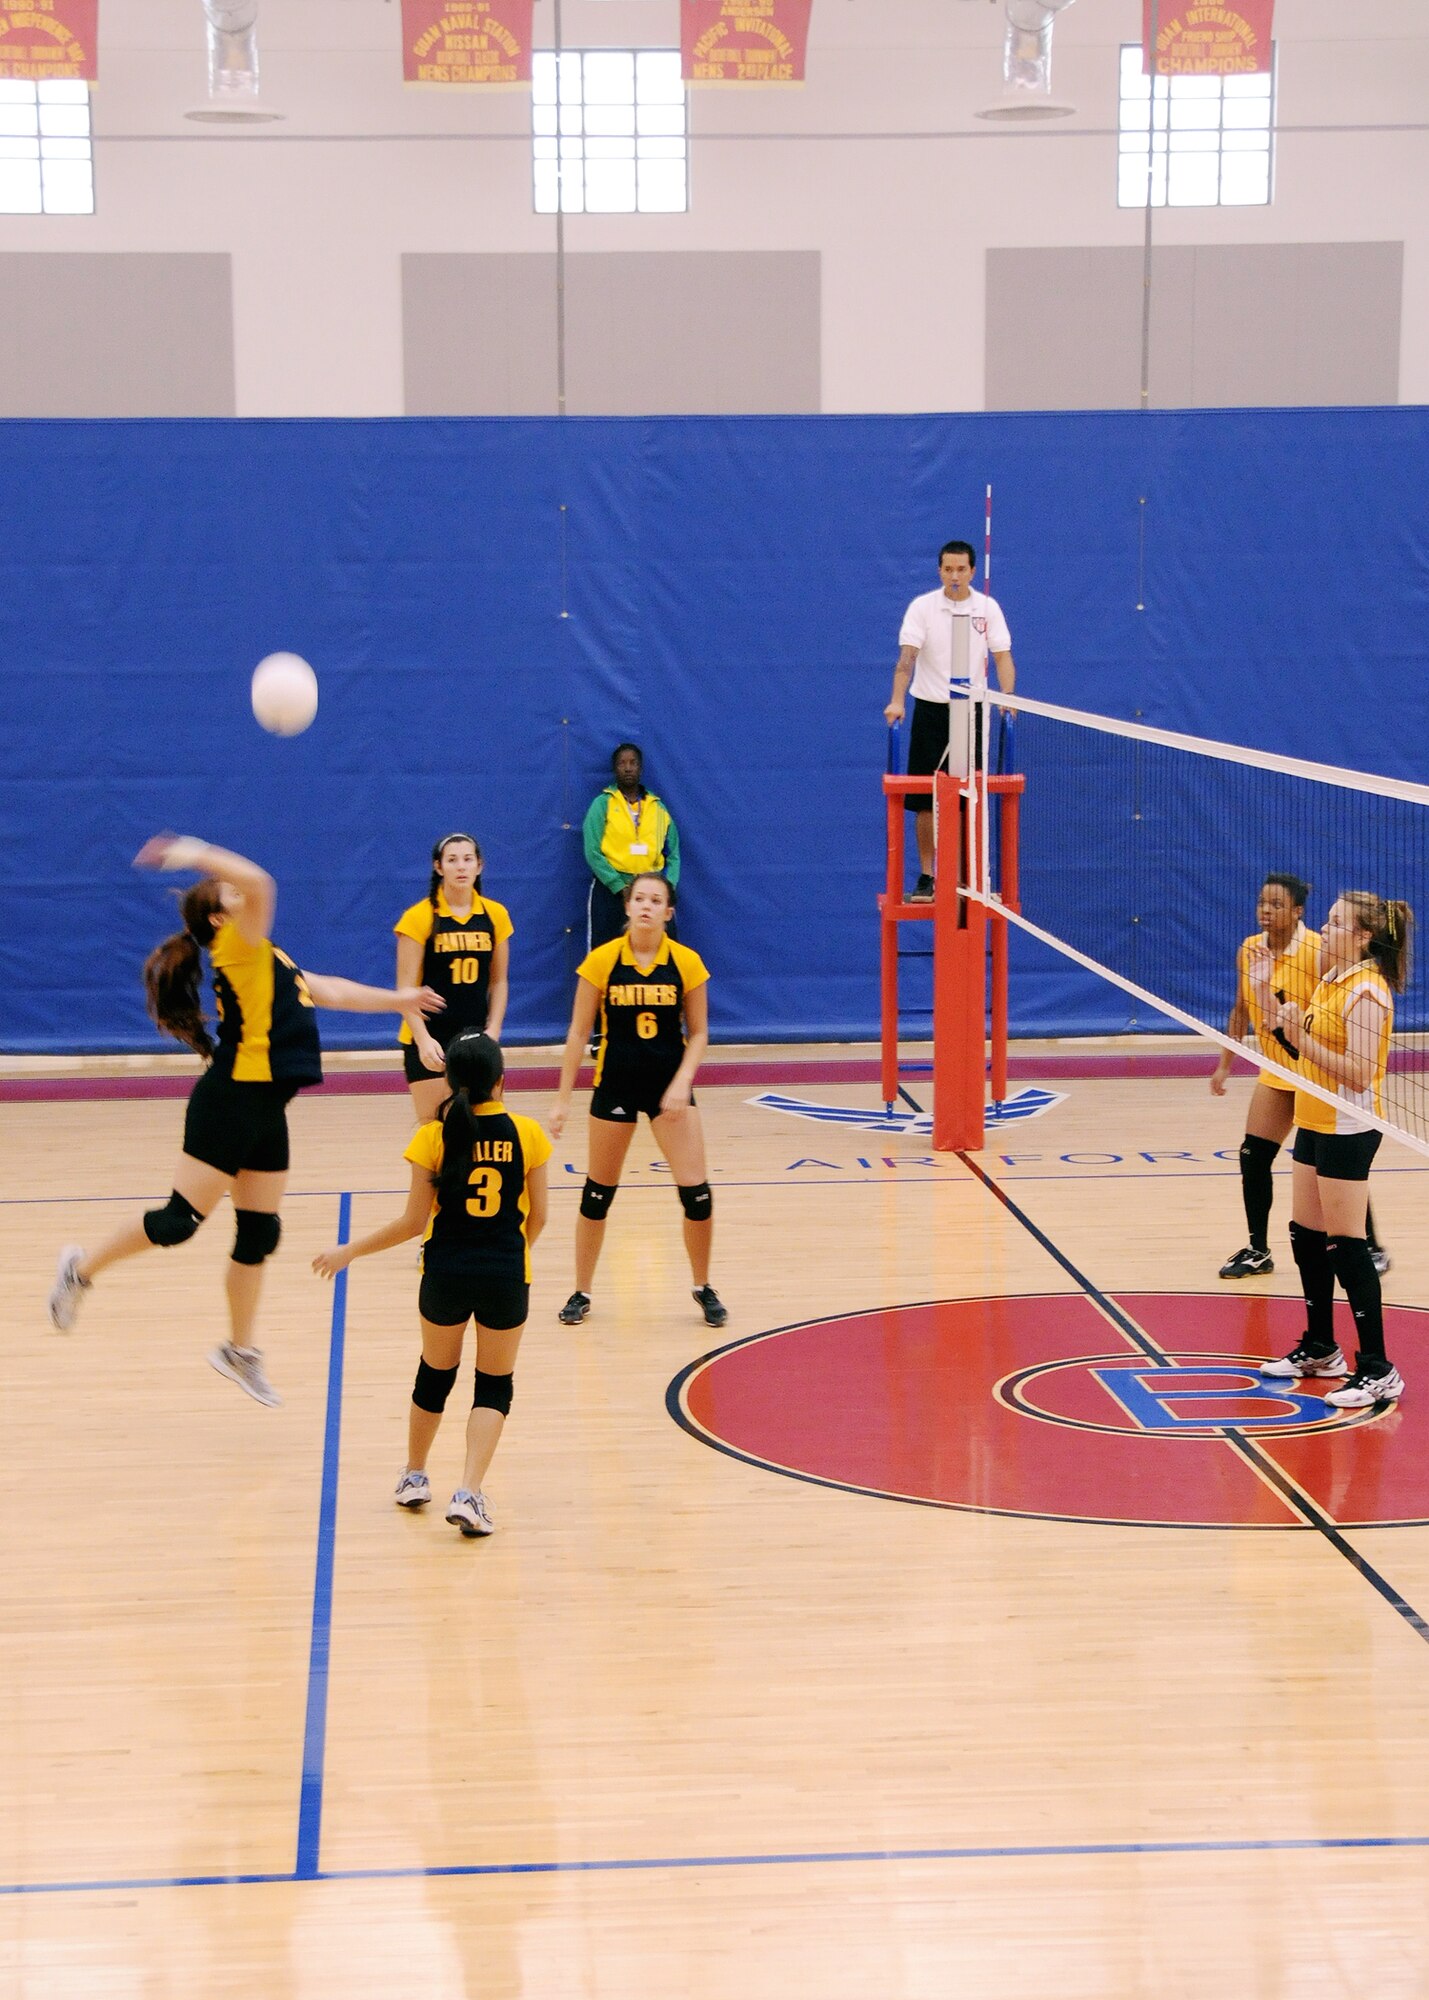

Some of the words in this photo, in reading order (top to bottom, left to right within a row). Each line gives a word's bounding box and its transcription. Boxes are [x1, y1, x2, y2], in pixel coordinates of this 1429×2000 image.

[440, 13, 480, 33] NAVAL
[483, 17, 521, 57] STATION
[693, 21, 728, 58] PACIFIC
[734, 17, 794, 59] INVITATIONAL
[1186, 7, 1258, 49] INTERNATIONAL
[444, 34, 488, 50] NISSAN
[13, 62, 80, 78] CHAMPIONS
[450, 64, 517, 81] CHAMPIONS
[693, 63, 724, 79] MENS
[1157, 56, 1259, 73] CHAMPIONS
[434, 931, 493, 953] PANTHERS
[449, 957, 479, 985] 10
[609, 984, 677, 1006] PANTHERS
[636, 1011, 658, 1040] 6
[786, 1156, 943, 1169] AIR
[465, 1166, 503, 1218] 3
[1087, 1366, 1344, 1431] B
